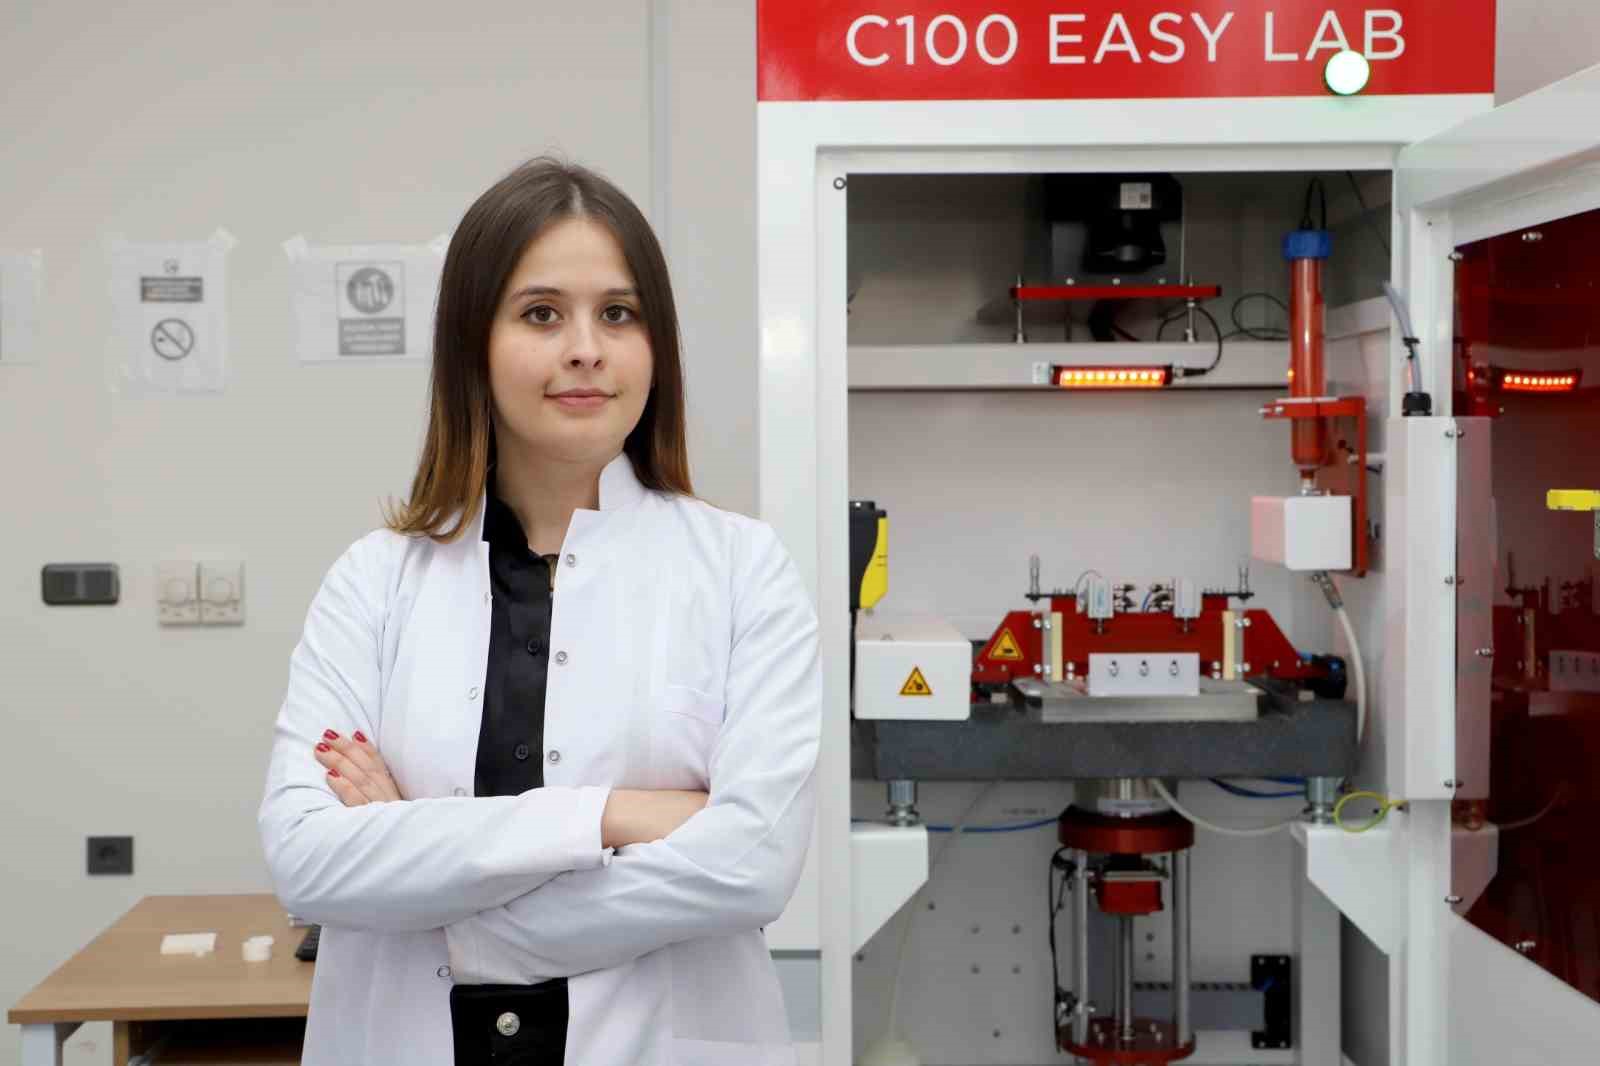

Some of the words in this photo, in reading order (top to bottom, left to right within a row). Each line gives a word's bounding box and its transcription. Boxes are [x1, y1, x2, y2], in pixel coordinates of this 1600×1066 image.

[846, 14, 1018, 67] C100
[1049, 11, 1235, 64] EASY
[1264, 9, 1406, 62] LAB
